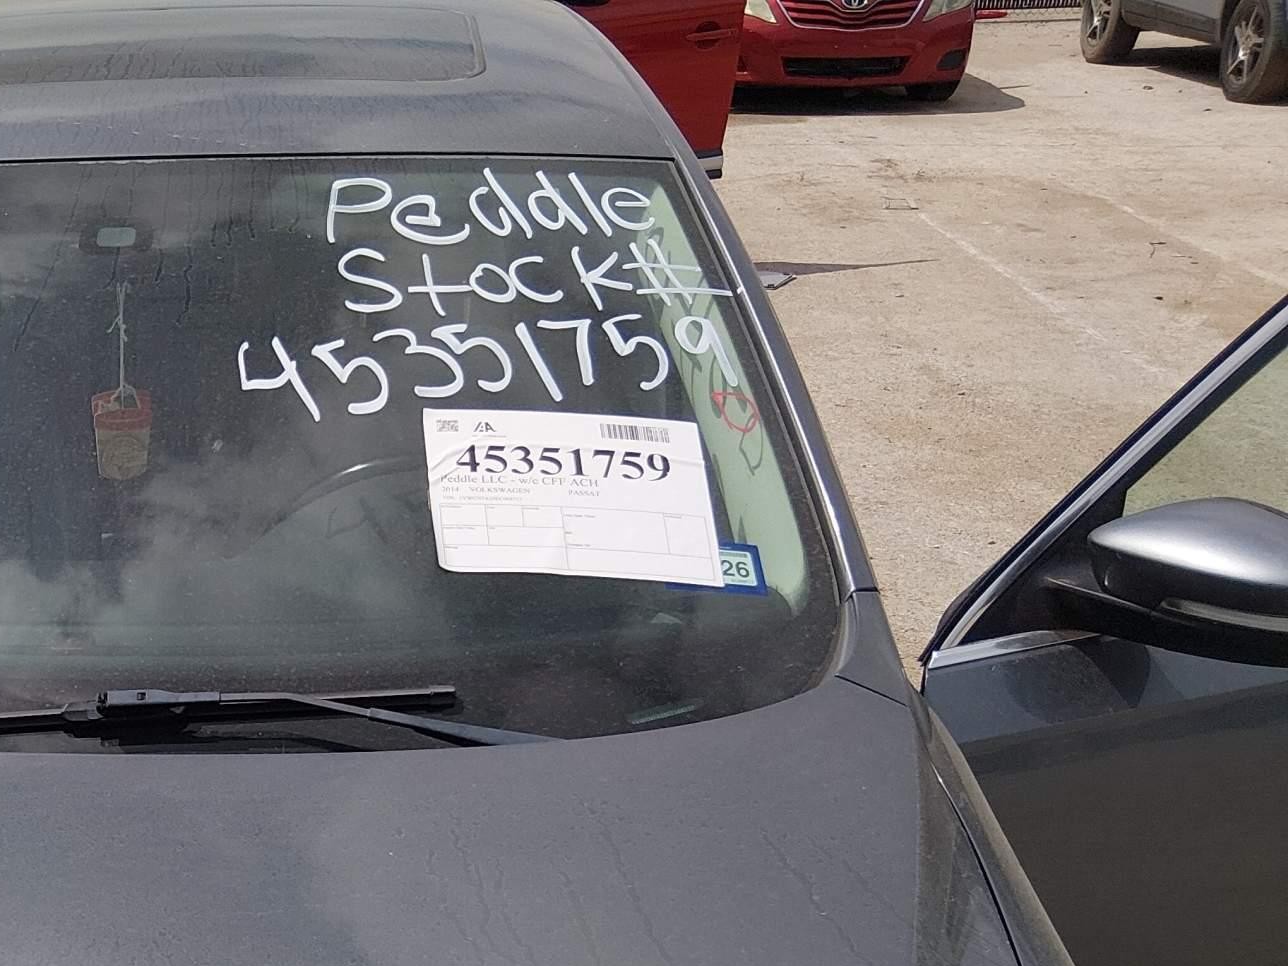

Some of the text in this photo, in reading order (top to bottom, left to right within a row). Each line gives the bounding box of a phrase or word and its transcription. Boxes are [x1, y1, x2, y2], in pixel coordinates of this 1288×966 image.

[326, 167, 656, 246] Peddle
[237, 314, 738, 422] 45351759
[456, 444, 670, 481] 45351759
[440, 474, 478, 484] Peddle
[481, 475, 506, 484] LLC
[570, 478, 599, 488] ACH
[468, 486, 531, 494] VOLKSWAGEN
[568, 489, 601, 497] PASSAT
[721, 559, 750, 578] 26
